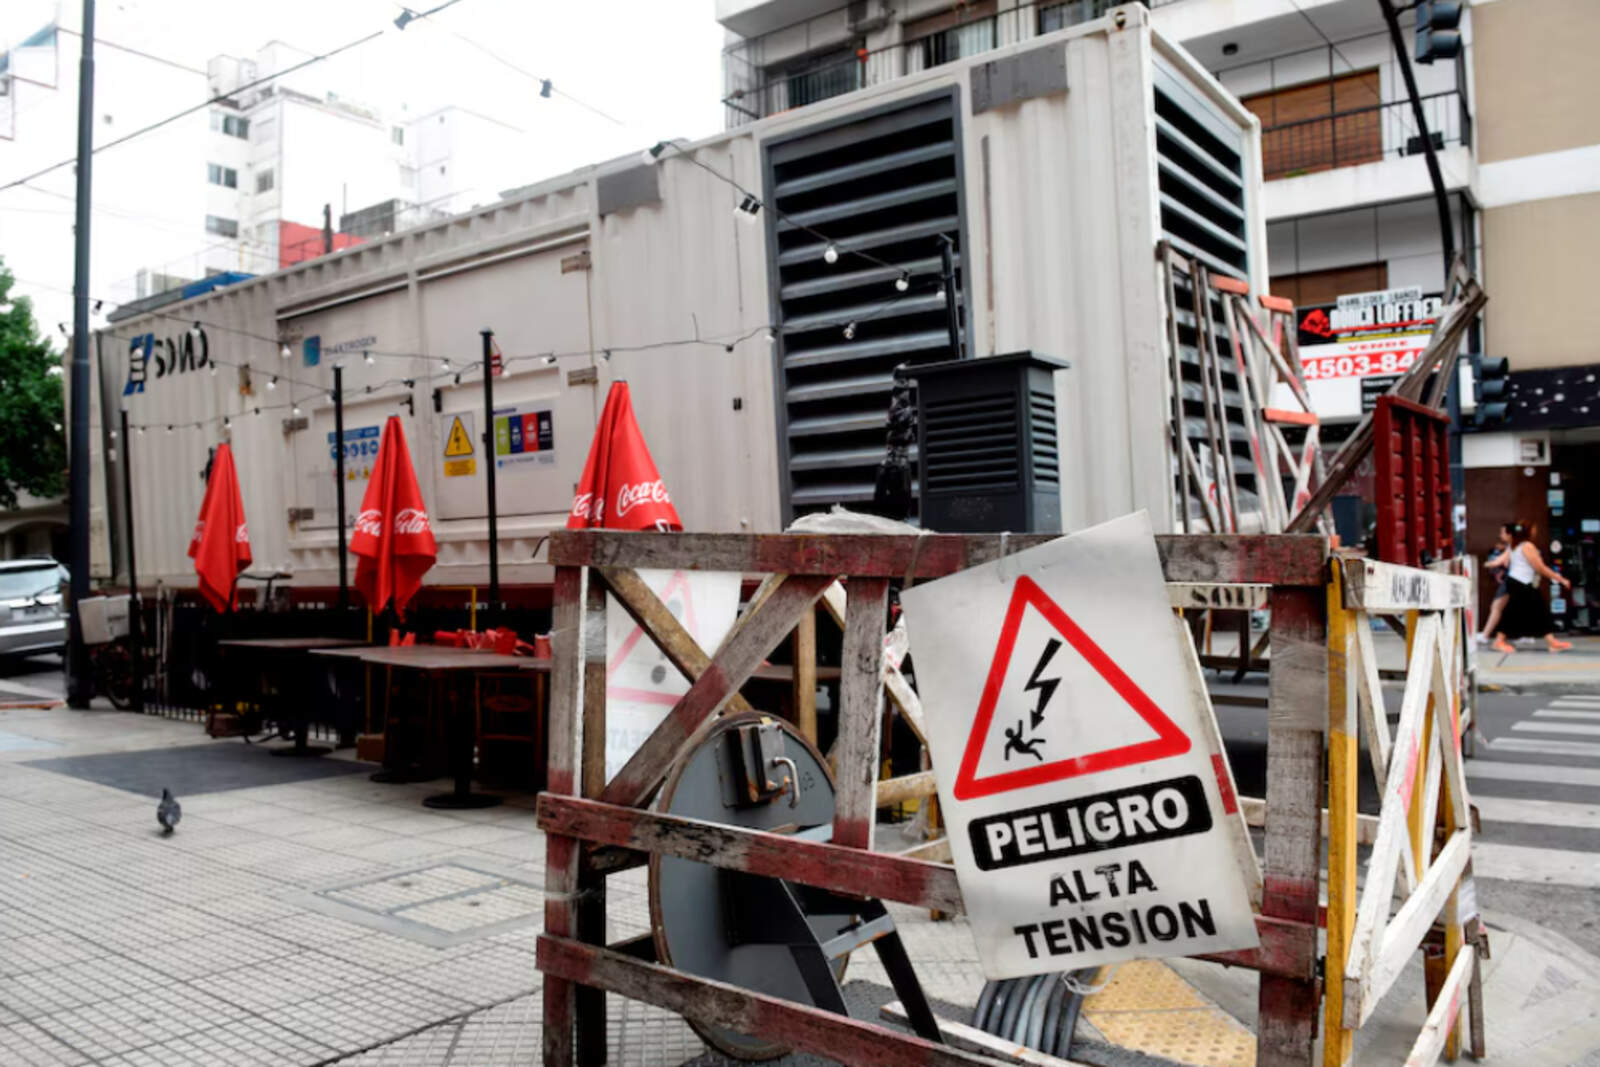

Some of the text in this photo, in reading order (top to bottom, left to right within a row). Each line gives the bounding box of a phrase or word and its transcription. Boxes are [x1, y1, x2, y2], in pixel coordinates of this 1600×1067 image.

[985, 787, 1189, 861] PELIGRO
[1049, 860, 1158, 907] ALTA
[1013, 899, 1217, 959] TENSION
